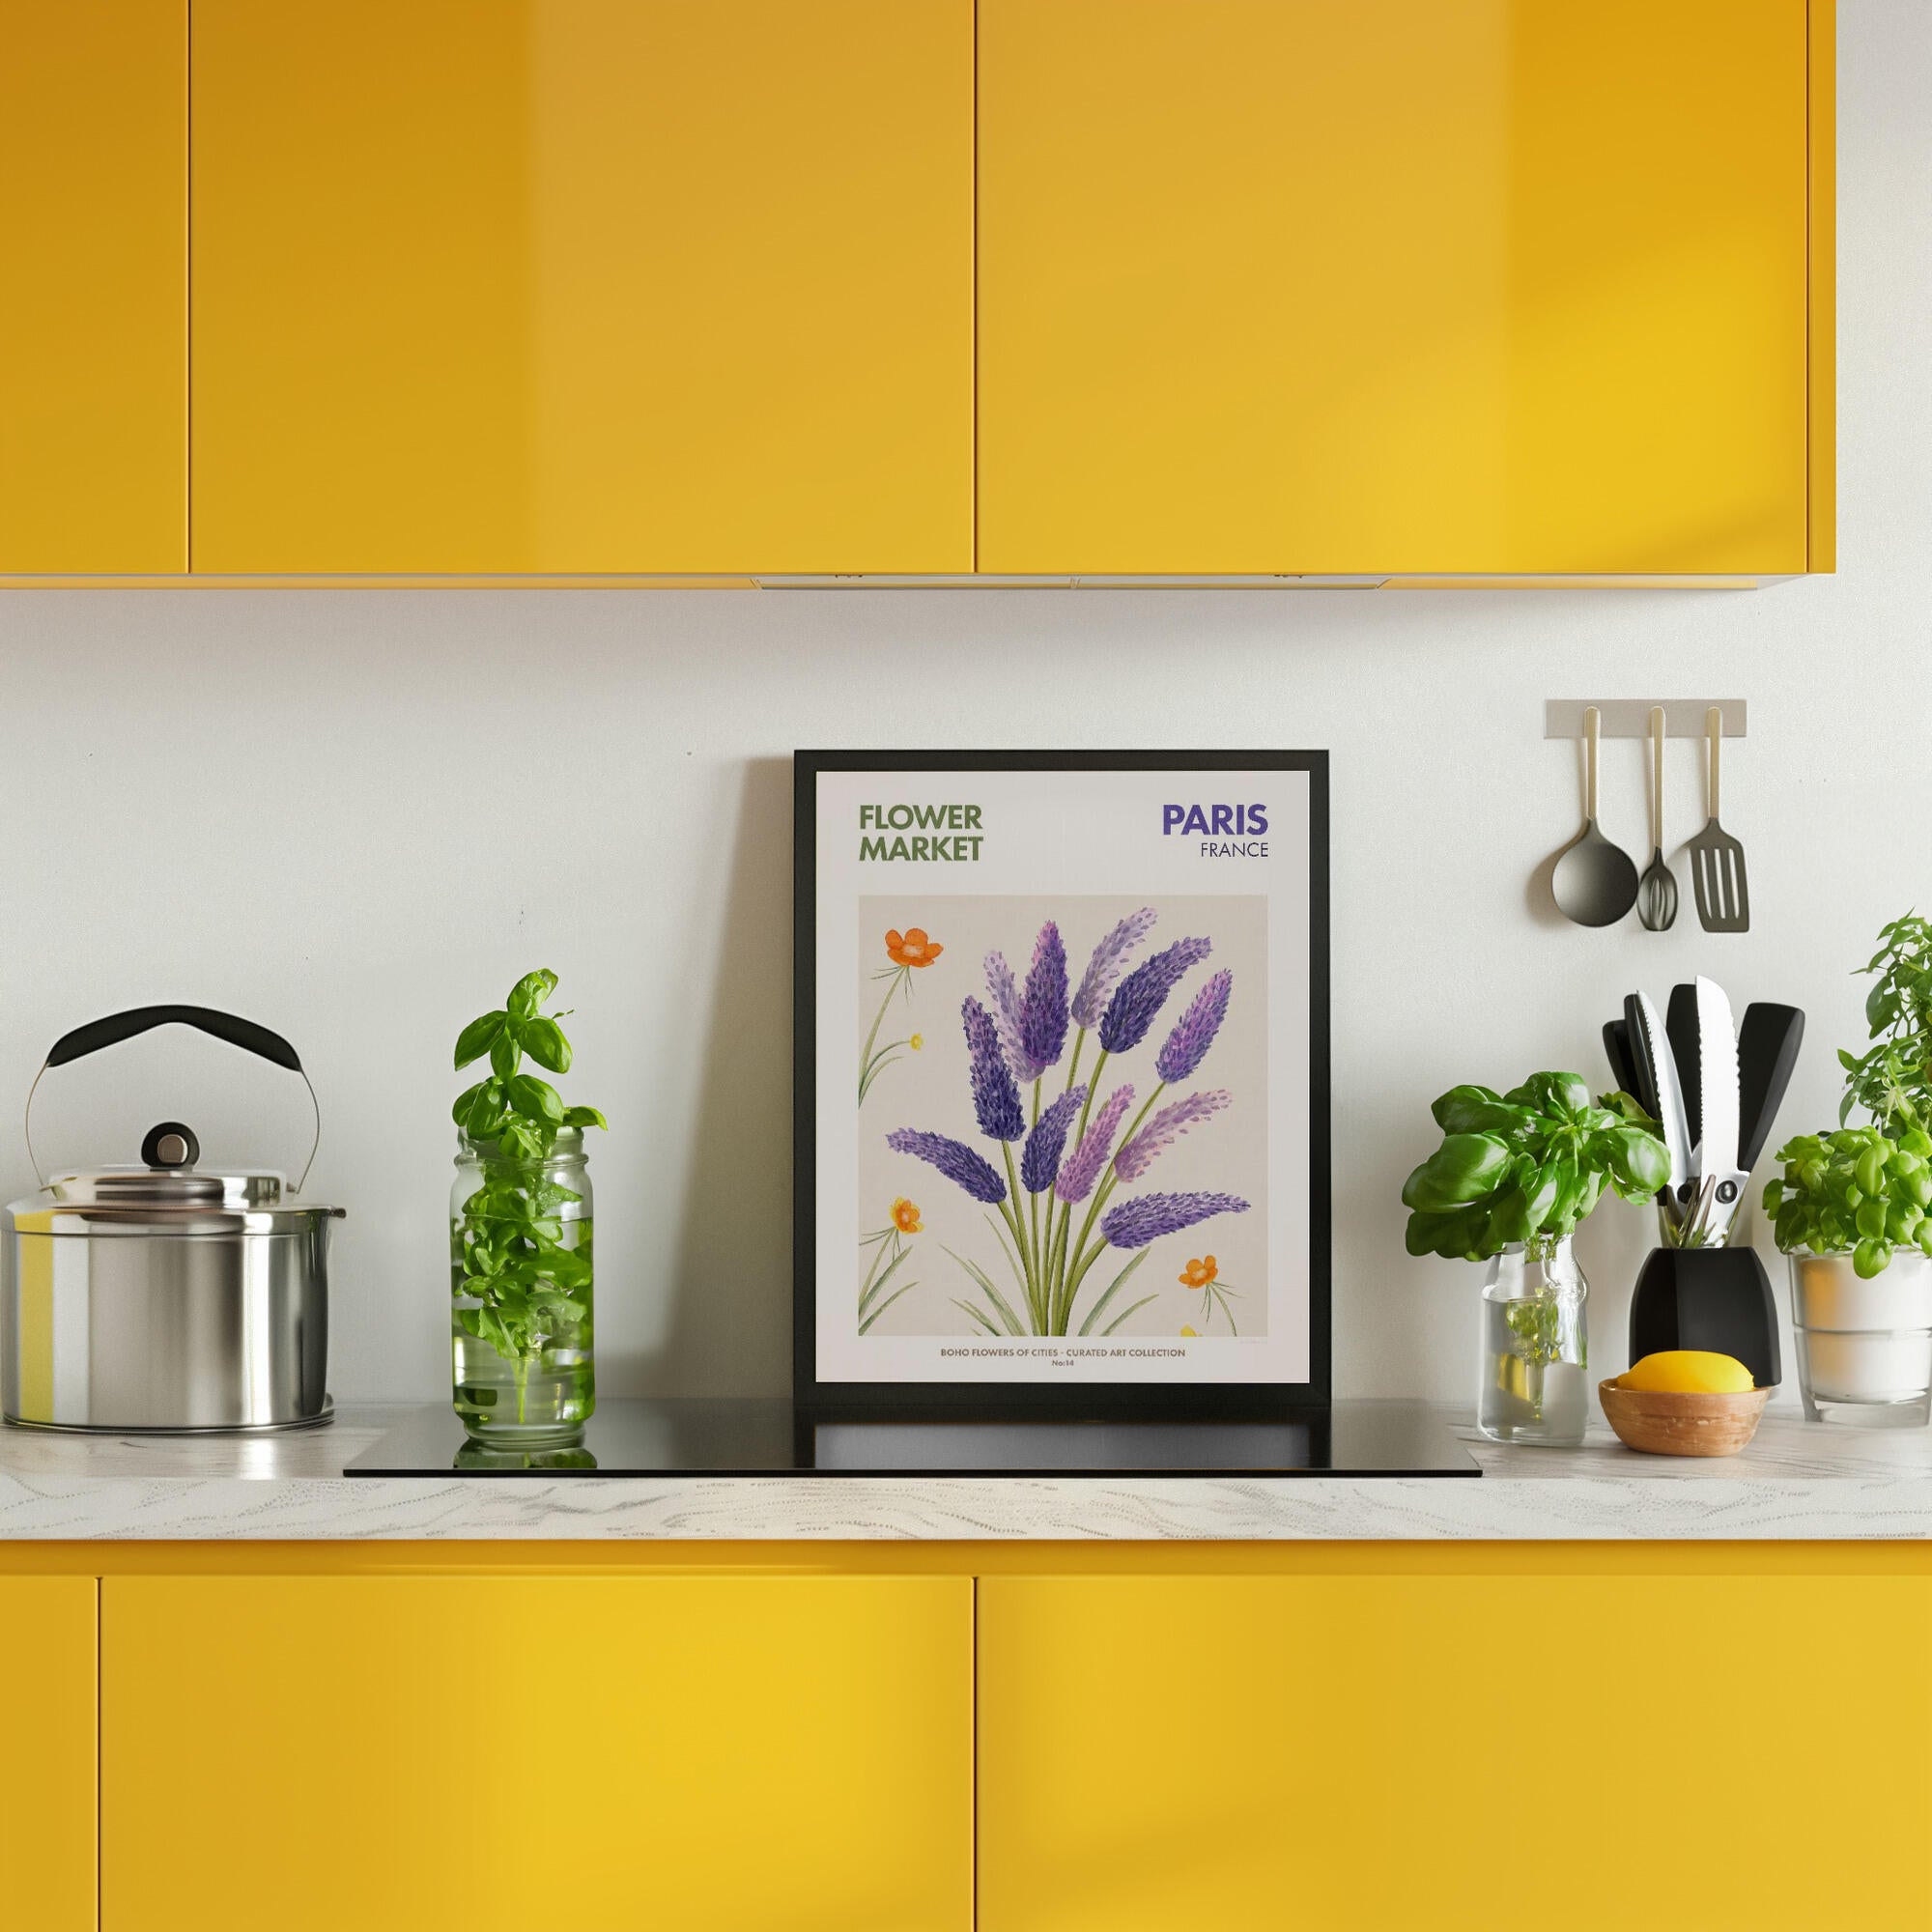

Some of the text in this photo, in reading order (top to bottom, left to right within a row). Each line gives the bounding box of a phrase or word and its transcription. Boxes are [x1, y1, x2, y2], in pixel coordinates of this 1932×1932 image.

[859, 804, 983, 831] FLOWER
[1162, 803, 1269, 836] PARIS
[859, 836, 984, 862] MARKET
[1201, 841, 1269, 858] FRANCE
[940, 1348, 970, 1357] BOHO
[971, 1348, 1015, 1357] FLOWERS
[1015, 1348, 1030, 1357] OF
[1031, 1349, 1059, 1357] CITIES
[1065, 1349, 1108, 1357] CURATED
[1109, 1349, 1127, 1357] ART
[1128, 1349, 1186, 1357] COLLECTION
